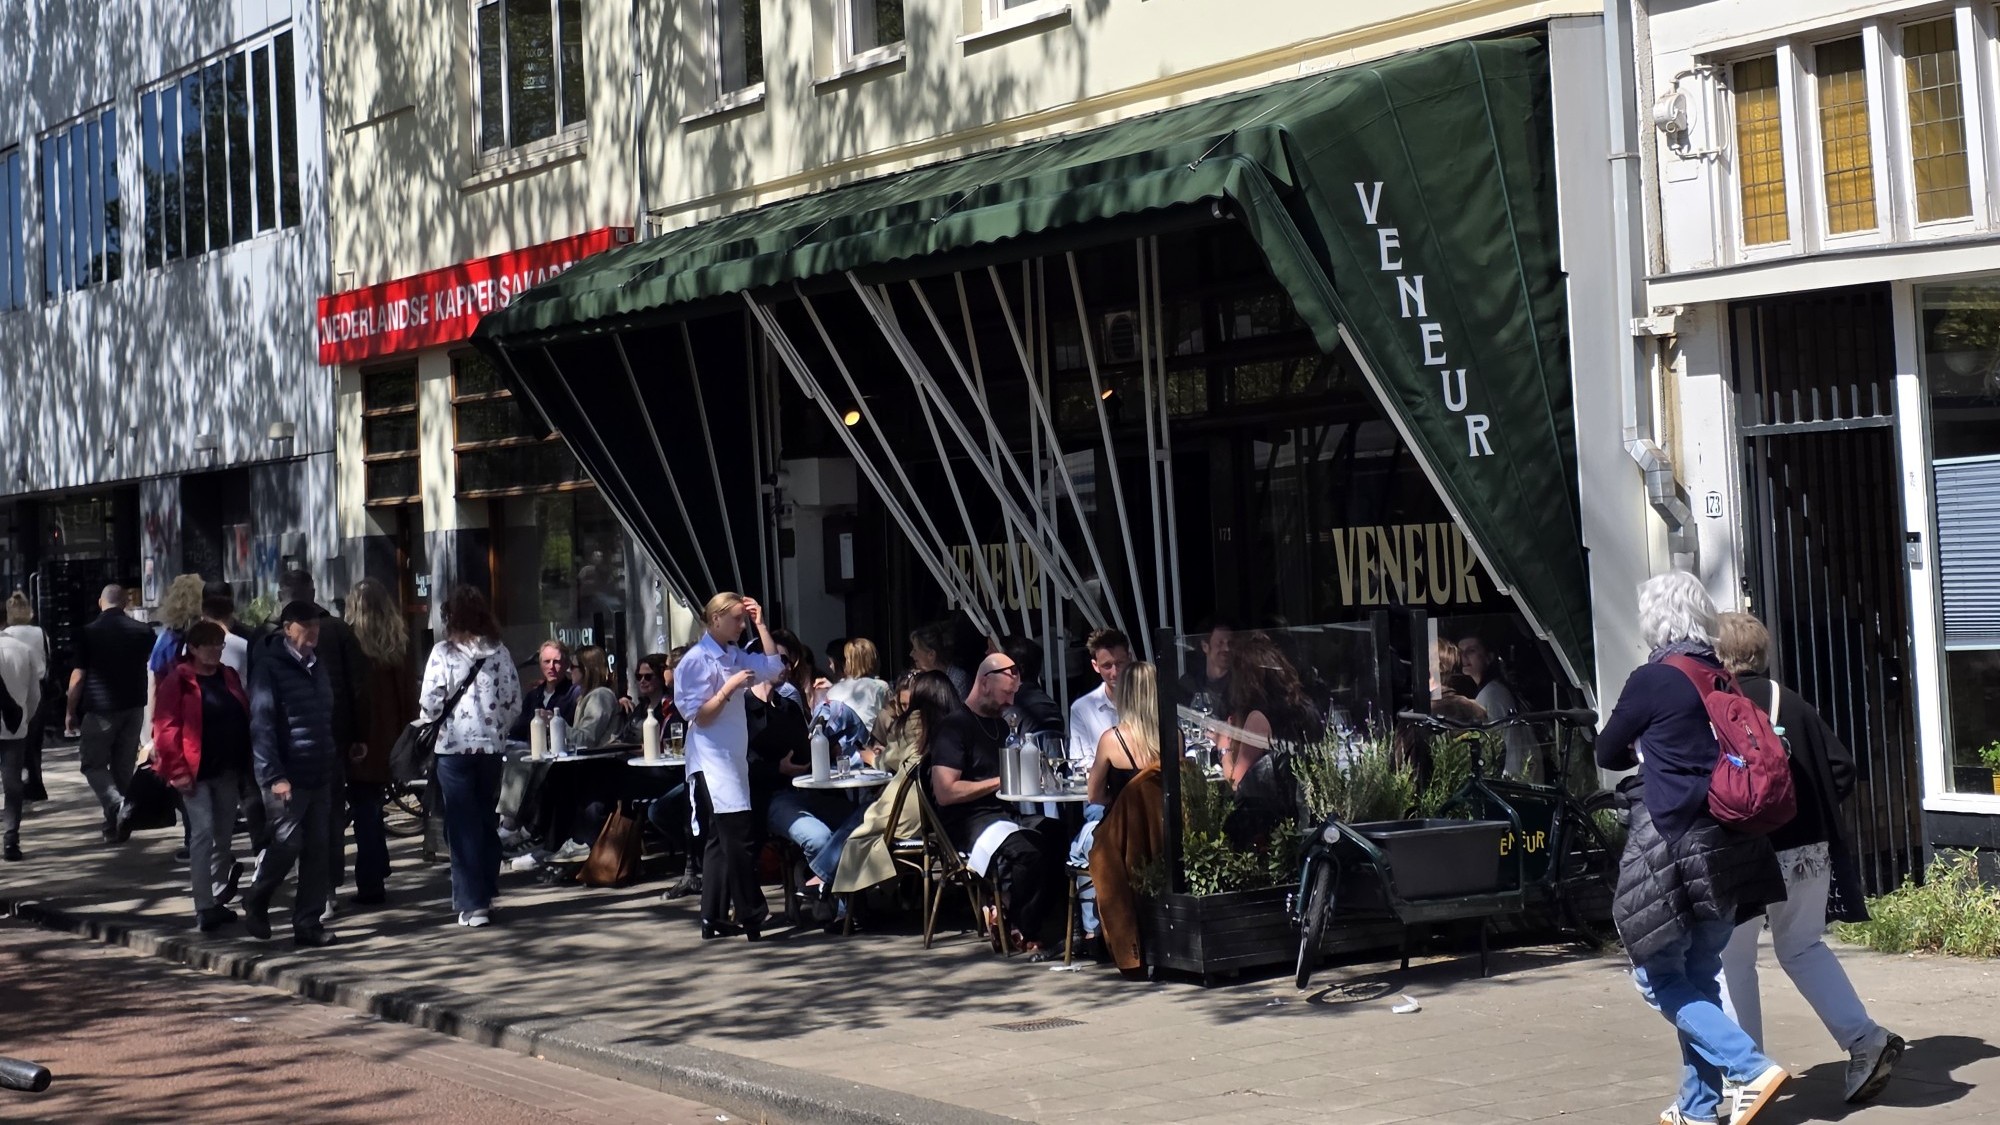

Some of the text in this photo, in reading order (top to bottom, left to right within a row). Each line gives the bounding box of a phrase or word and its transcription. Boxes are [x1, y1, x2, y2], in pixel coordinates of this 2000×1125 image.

[321, 260, 579, 346] NEDERLANDSE KAPPERSAKA
[1353, 181, 1495, 457] VENEUR
[1705, 495, 1720, 514] 173
[1332, 522, 1482, 606] VENEUR
